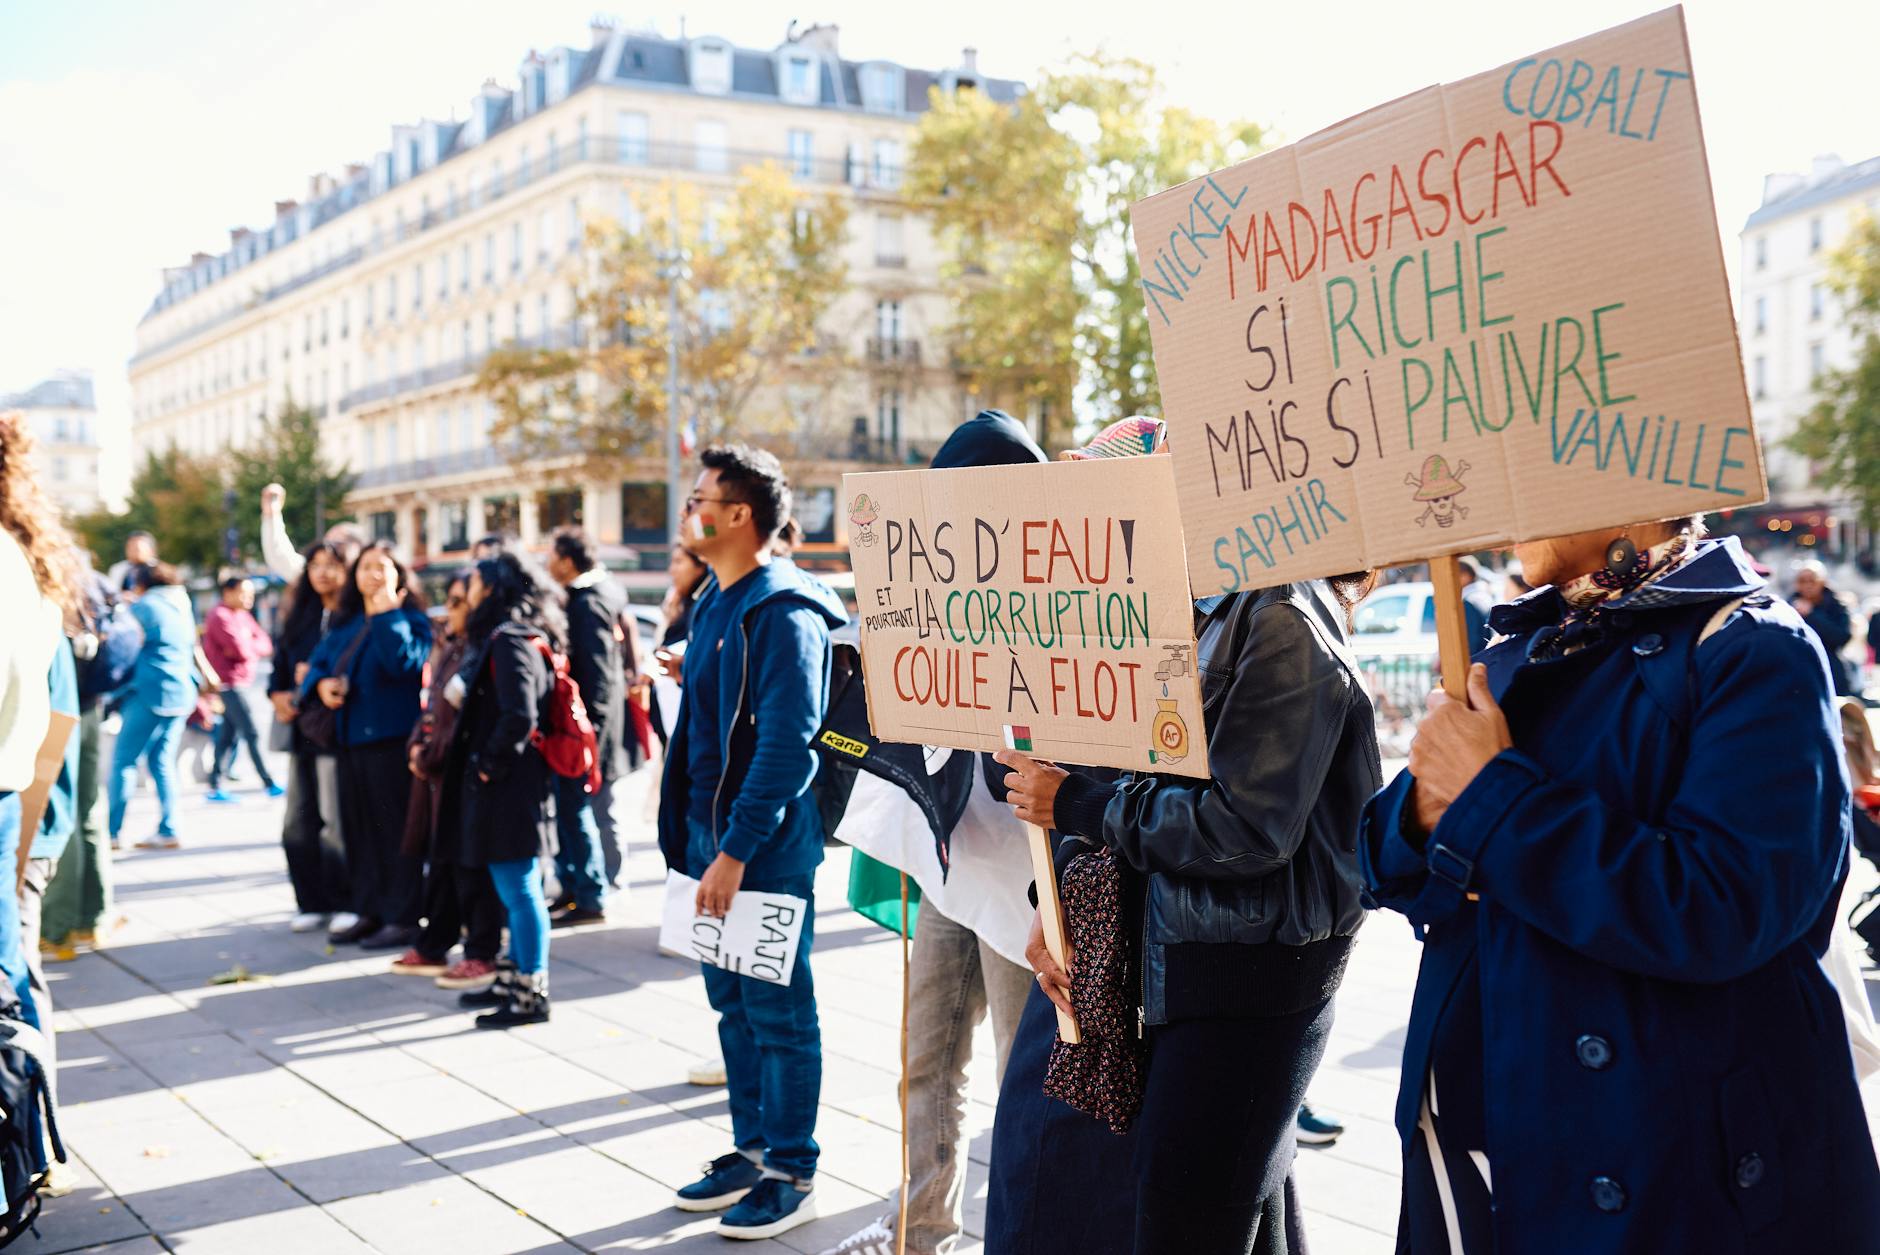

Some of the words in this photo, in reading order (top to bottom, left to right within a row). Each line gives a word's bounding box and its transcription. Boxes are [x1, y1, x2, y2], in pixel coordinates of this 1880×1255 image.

[1503, 58, 1689, 141] COBALT
[1225, 120, 1572, 300] MADAGASCAR
[1400, 303, 1638, 451] PAUVRE
[886, 518, 956, 584] PAS
[866, 607, 914, 633] POURTANT
[876, 586, 892, 606] ET
[914, 588, 945, 640] LA
[893, 645, 991, 711] COULE
[1007, 647, 1039, 714] À
[1050, 656, 1141, 723] FLOT
[751, 902, 795, 981] RAJO
